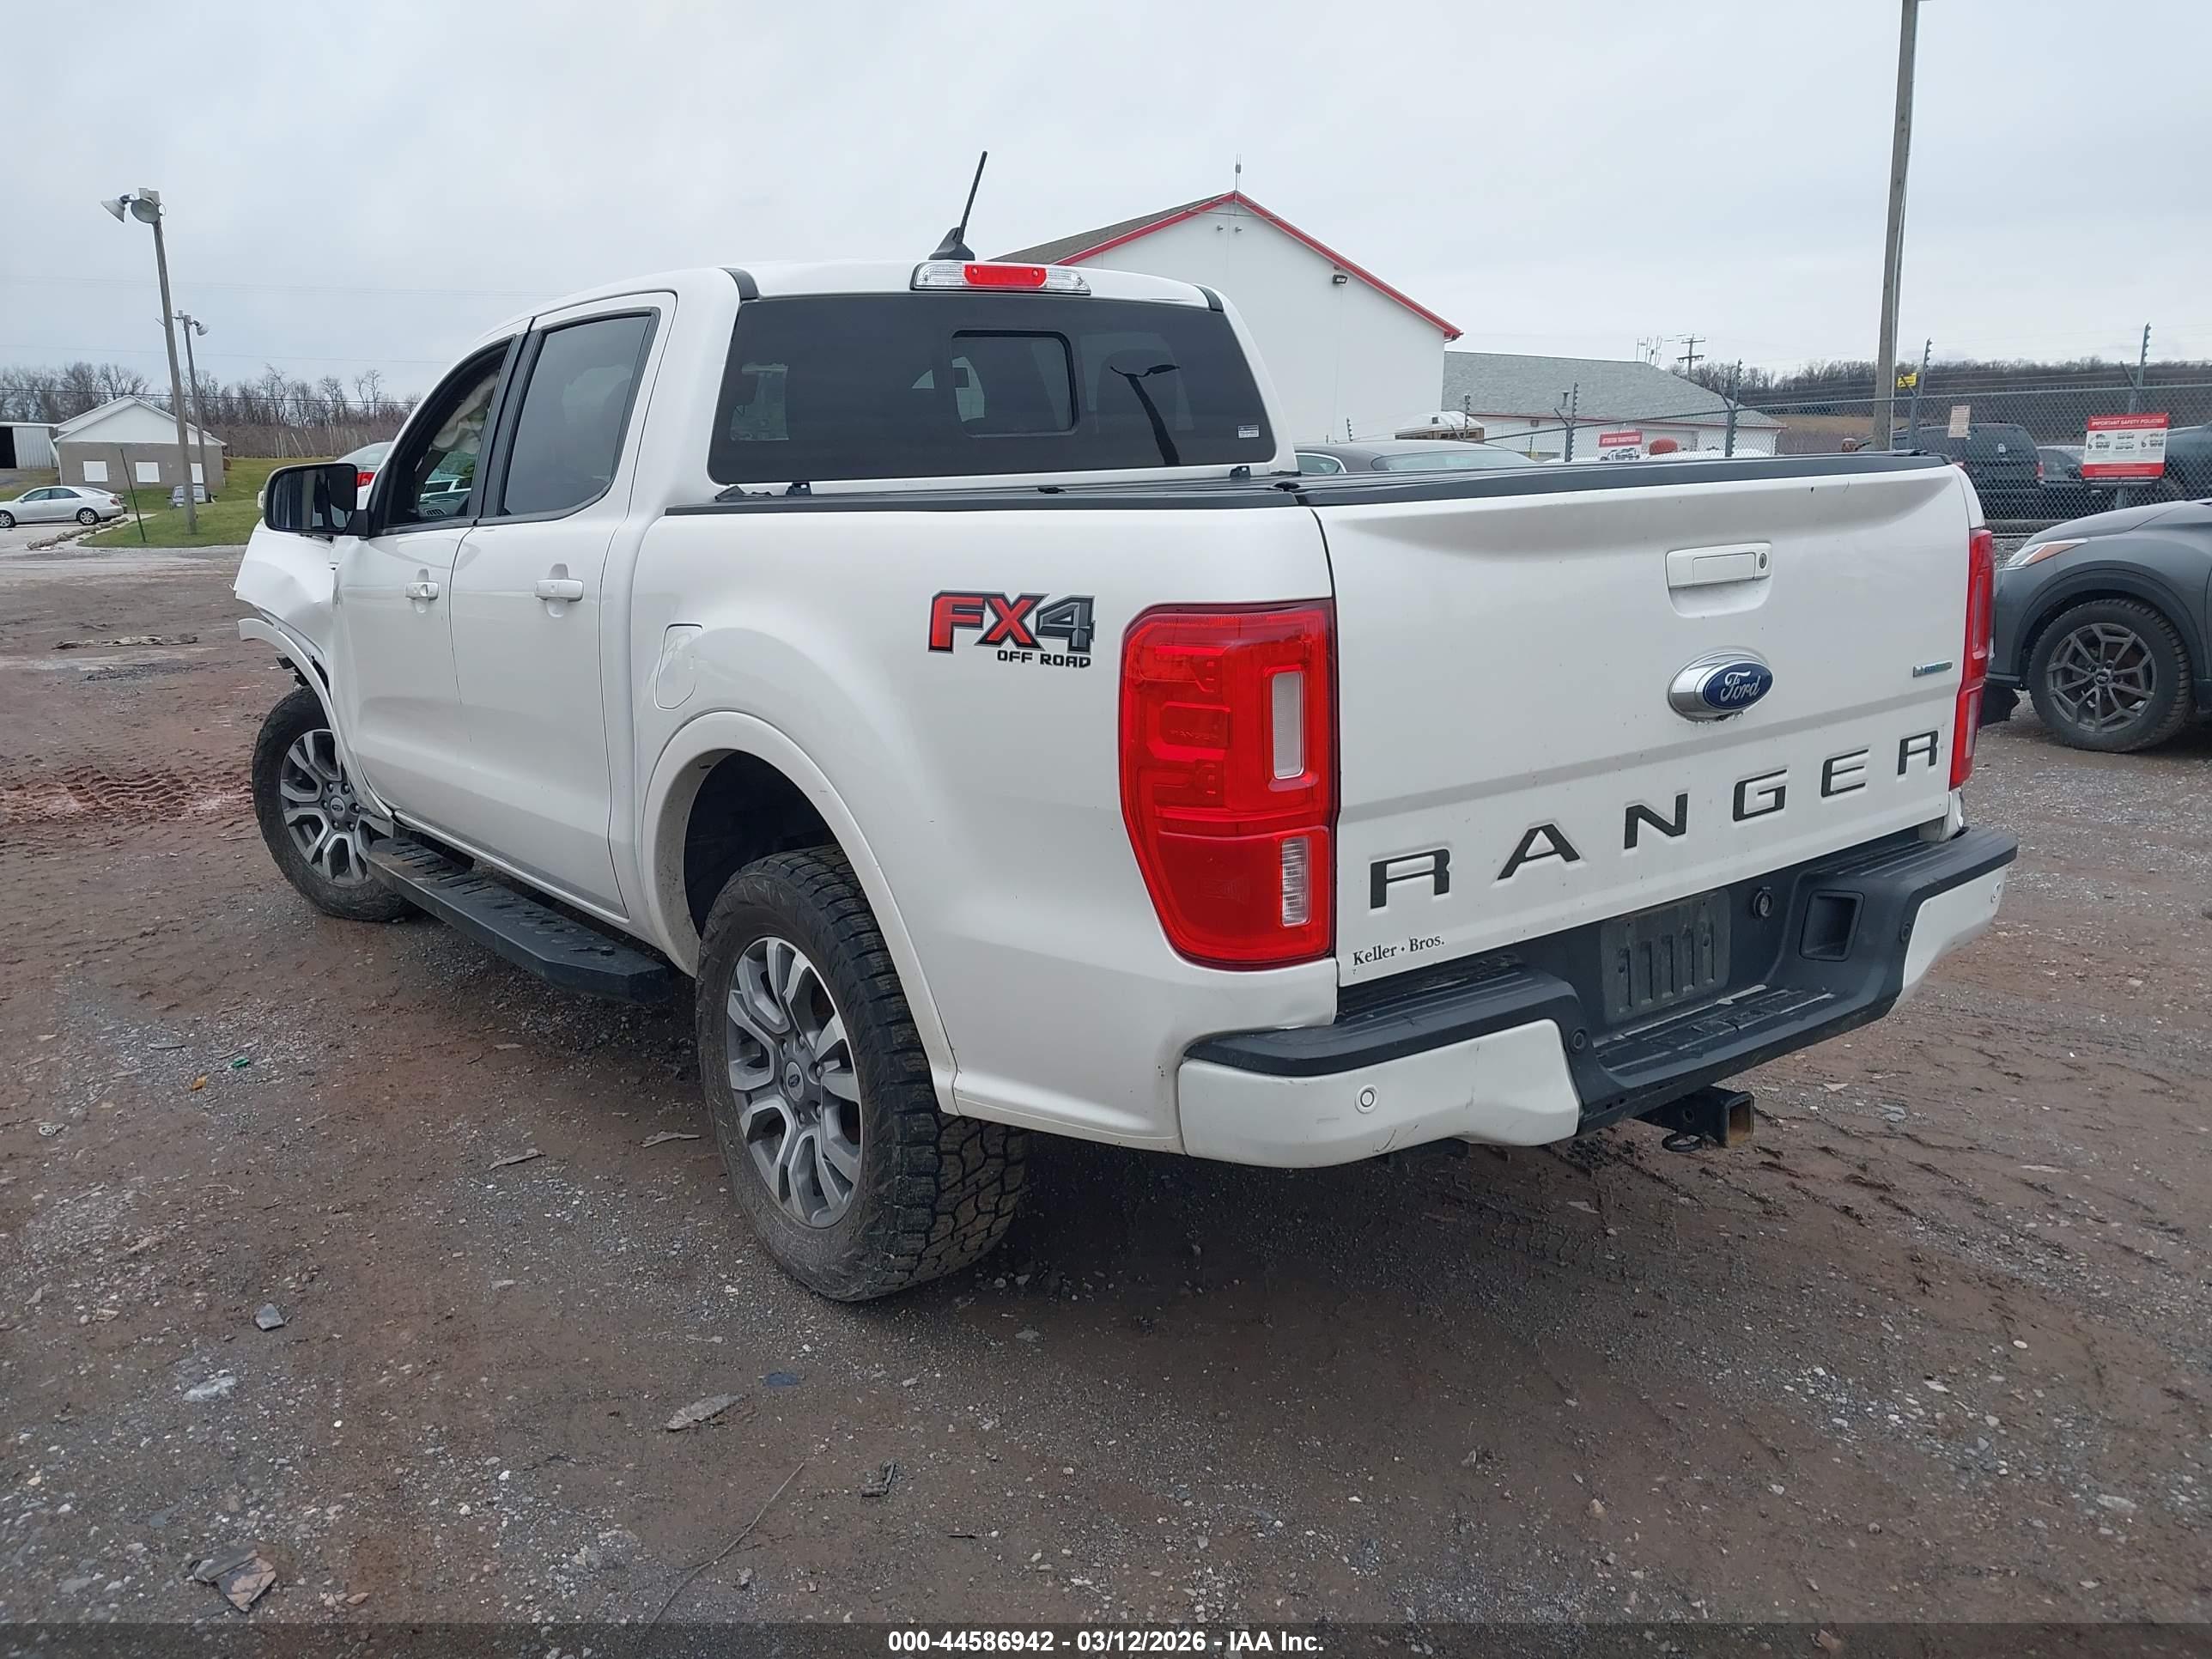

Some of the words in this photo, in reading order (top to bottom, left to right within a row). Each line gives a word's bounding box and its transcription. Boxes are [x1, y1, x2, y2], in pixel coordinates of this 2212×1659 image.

[928, 590, 1096, 654] FX4
[997, 650, 1033, 664] OFF
[1040, 653, 1091, 668] ROAD
[1720, 671, 1760, 702] Ford
[1370, 730, 1939, 910] RANGER
[1352, 945, 1397, 966] Keller
[1409, 935, 1444, 952] Bros.
